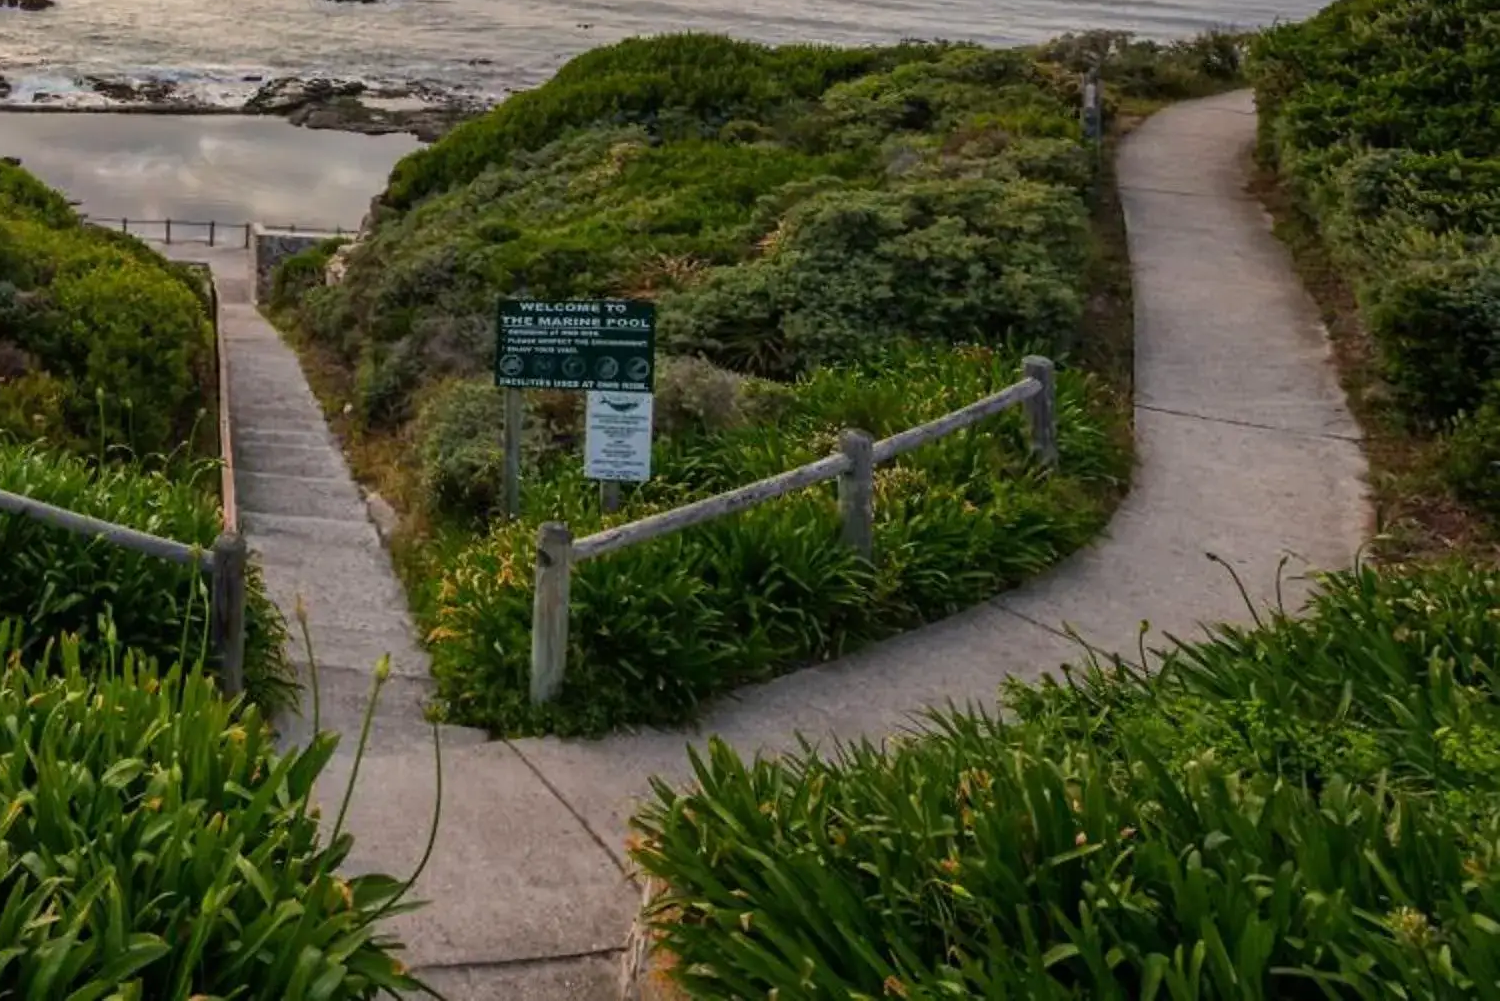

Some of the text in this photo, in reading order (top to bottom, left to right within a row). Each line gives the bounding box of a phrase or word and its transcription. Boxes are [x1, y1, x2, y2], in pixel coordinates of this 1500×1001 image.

[520, 302, 627, 313] WELCOME TO
[503, 316, 650, 327] THE MARINE POOL
[581, 380, 595, 388] AT
